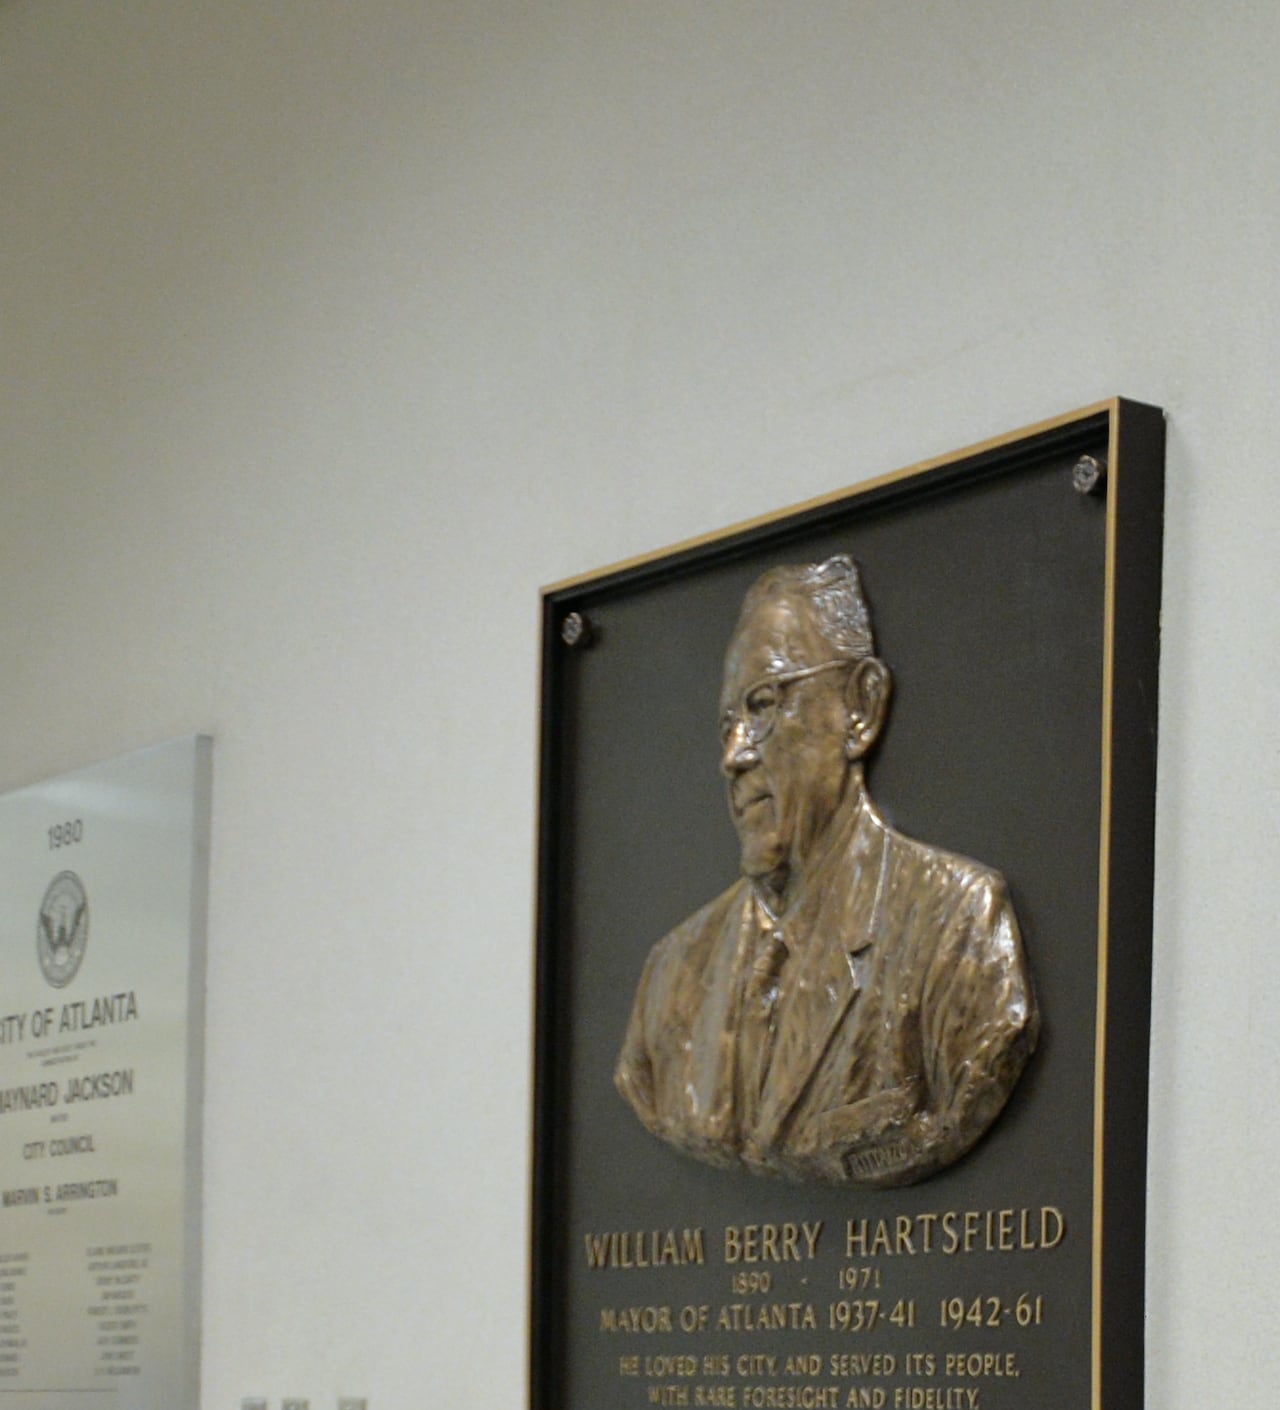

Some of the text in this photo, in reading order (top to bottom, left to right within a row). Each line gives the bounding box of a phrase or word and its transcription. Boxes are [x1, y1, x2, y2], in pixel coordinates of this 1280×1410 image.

[48, 819, 83, 850] 1980
[0, 991, 138, 1043] ITY OF ATLANTA
[64, 1069, 133, 1104] JACKSON
[584, 1206, 1065, 1268] WILLIAM BERRY HARTSFIELD
[732, 1271, 772, 1295] 1890
[839, 1267, 881, 1291] 1971
[601, 1306, 673, 1333] MAYOR
[680, 1304, 710, 1332] OF
[717, 1303, 817, 1330] ATLANTA
[619, 1355, 640, 1376] HE
[645, 1354, 698, 1377] LOVED
[703, 1353, 731, 1376] HIS
[784, 1354, 822, 1376] AND
[830, 1353, 896, 1377] SERVED
[906, 1353, 936, 1376] ITS
[648, 1385, 689, 1407] WITH
[694, 1385, 737, 1409] RARE
[743, 1385, 840, 1409] FORESIGHT
[846, 1386, 886, 1410] AND
